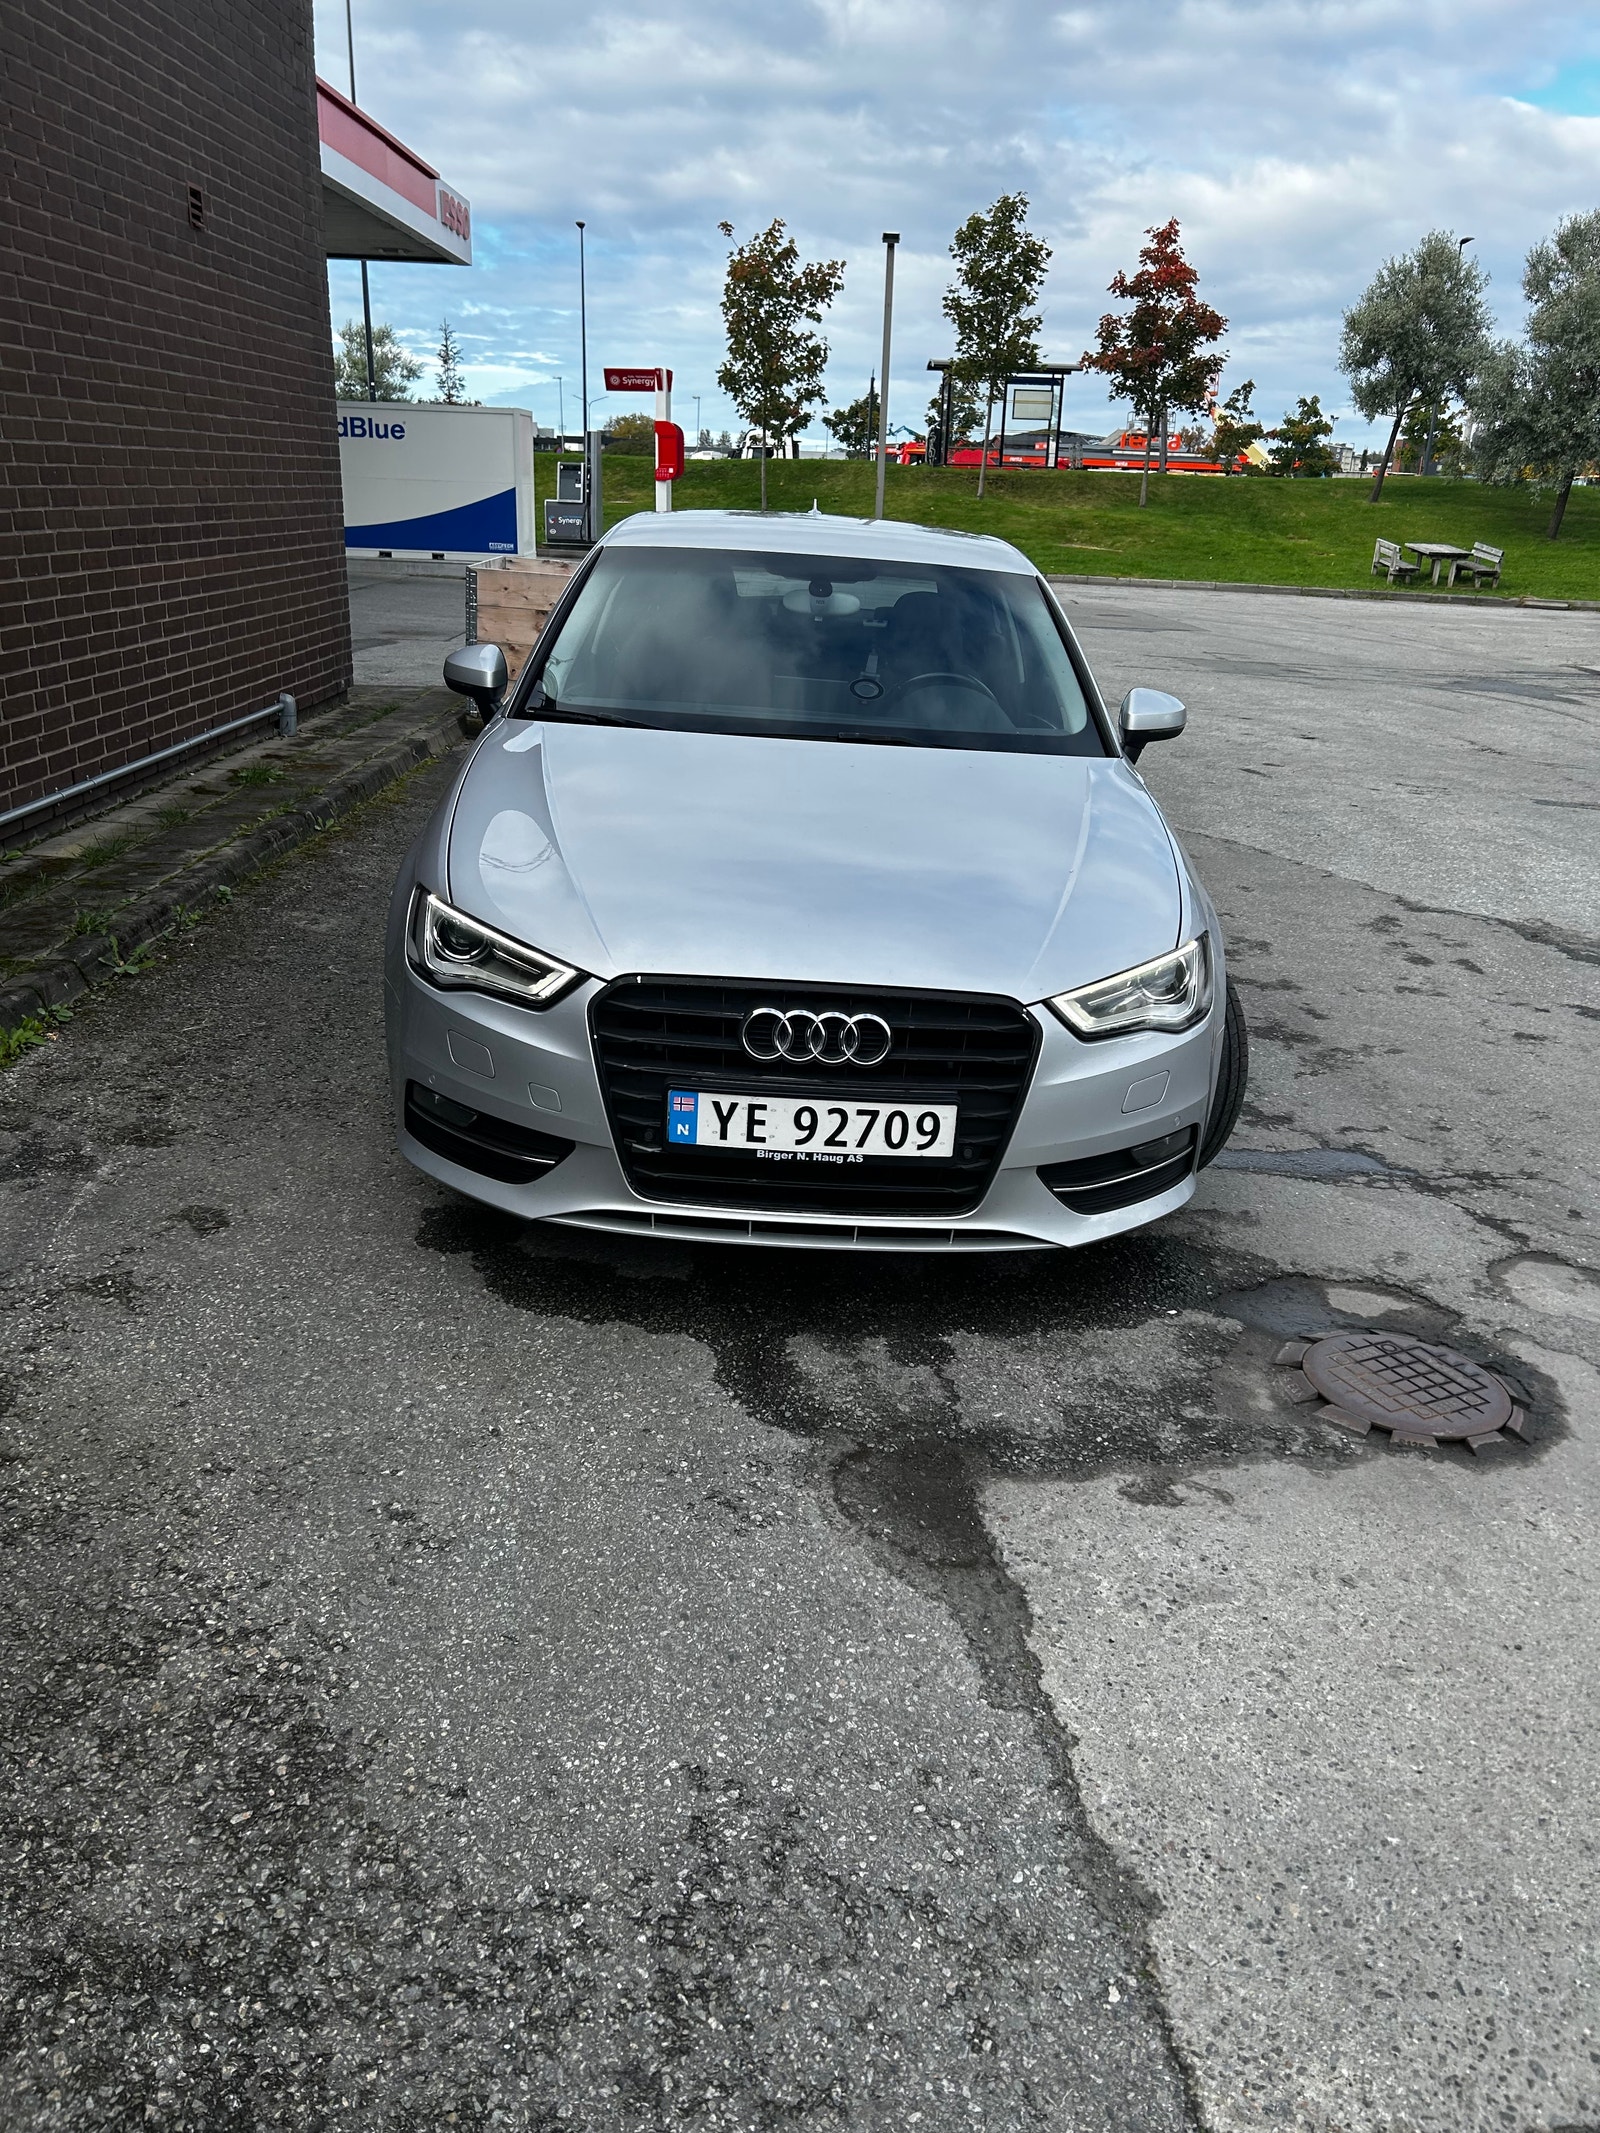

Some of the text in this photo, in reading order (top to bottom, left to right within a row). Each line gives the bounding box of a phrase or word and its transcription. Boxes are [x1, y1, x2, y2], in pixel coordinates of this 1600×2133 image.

[622, 376, 655, 387] Synergy
[337, 416, 406, 440] dBlue
[676, 1123, 690, 1136] N
[711, 1100, 941, 1151] YE 92709
[756, 1149, 864, 1164] Birger N. Haug AS
